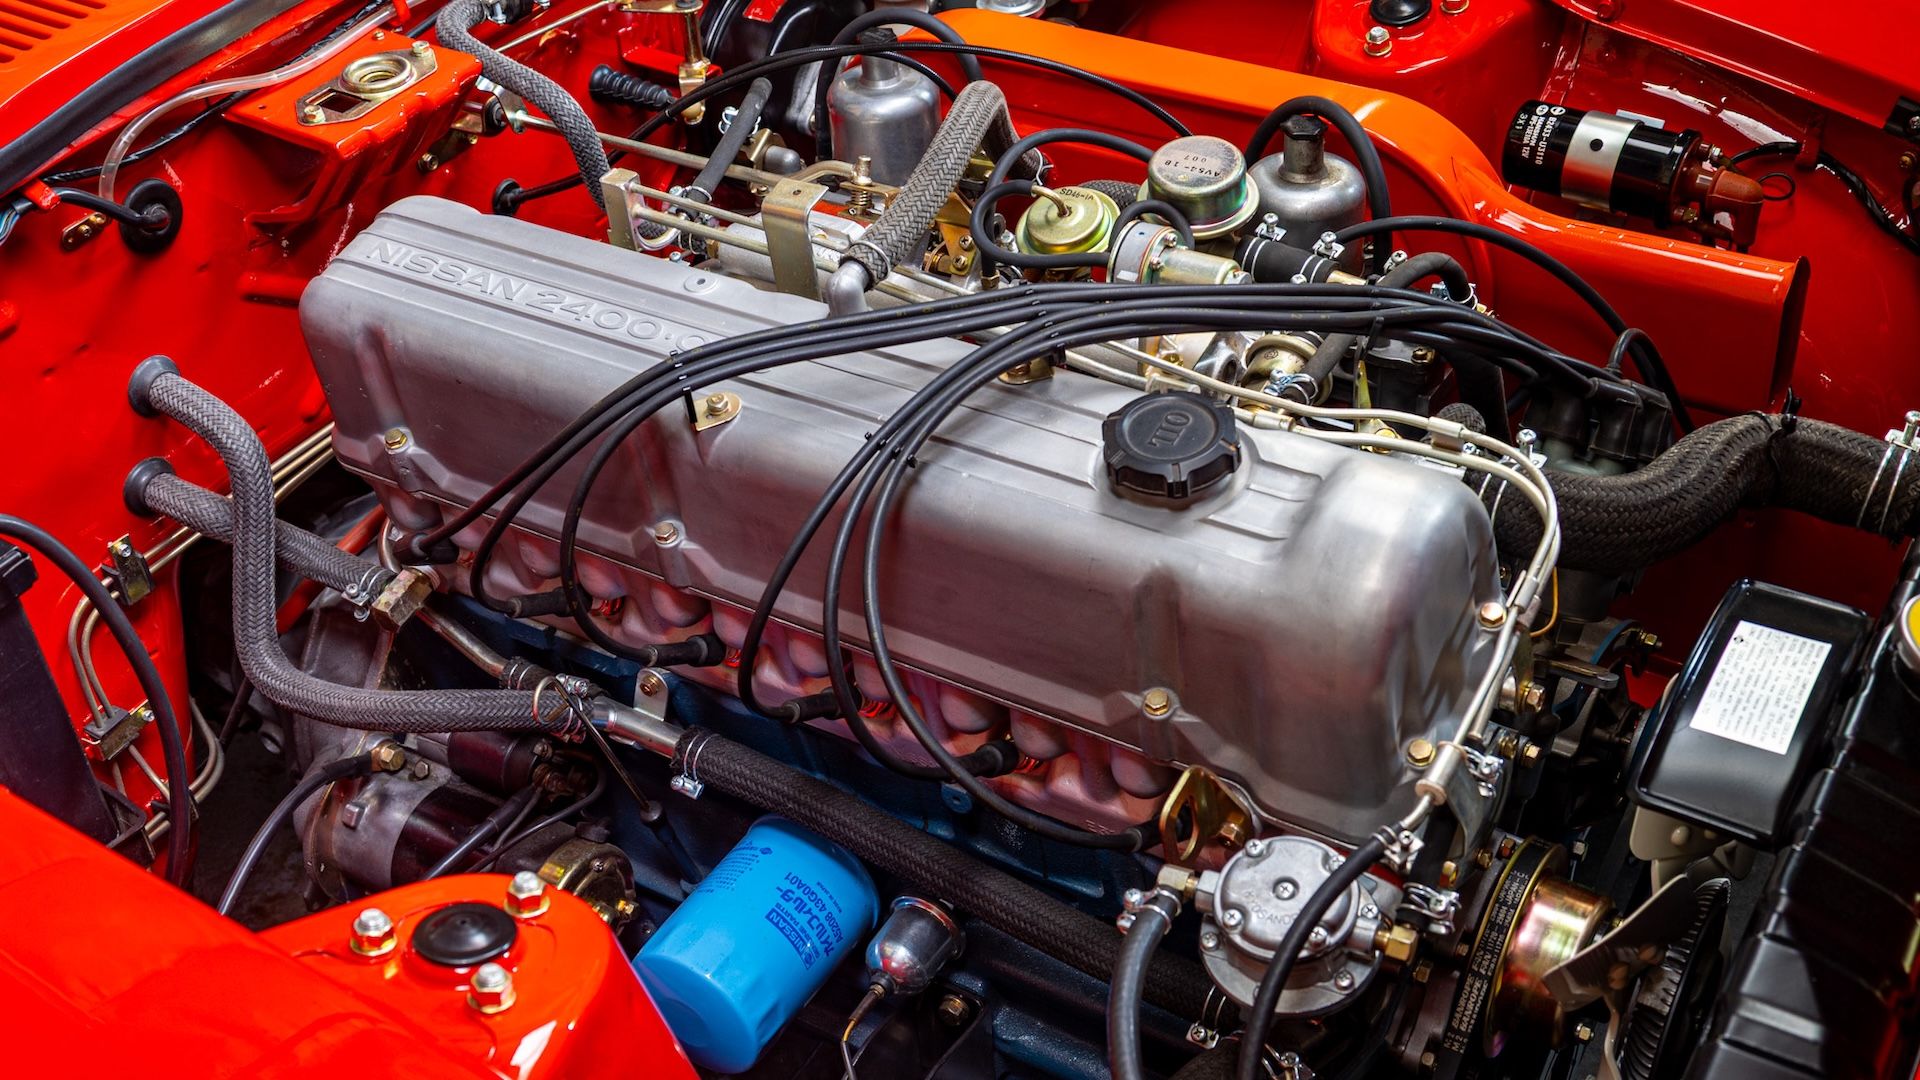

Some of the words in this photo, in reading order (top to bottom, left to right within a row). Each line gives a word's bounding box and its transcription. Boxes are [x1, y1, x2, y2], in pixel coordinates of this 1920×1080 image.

[366, 240, 529, 301] NISSAN
[1147, 410, 1193, 447] OIL
[769, 912, 806, 953] NISSAN
